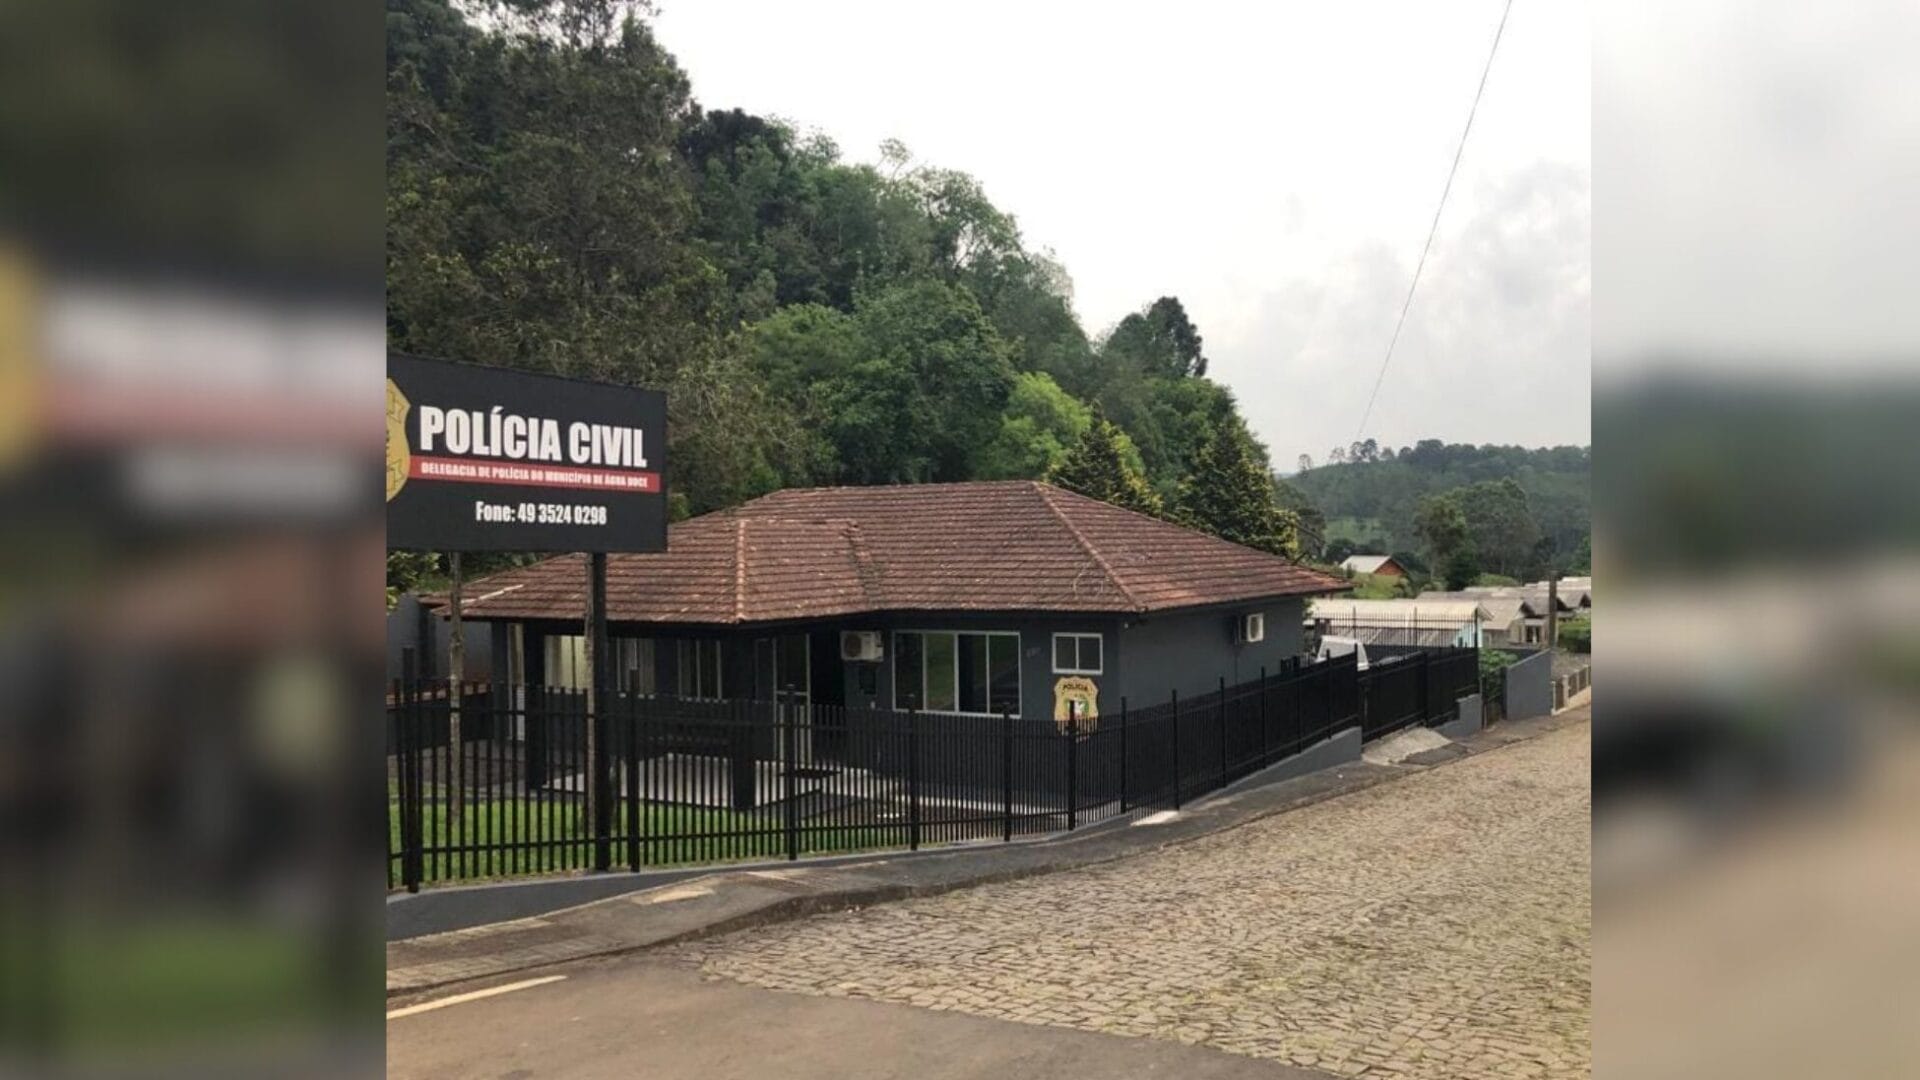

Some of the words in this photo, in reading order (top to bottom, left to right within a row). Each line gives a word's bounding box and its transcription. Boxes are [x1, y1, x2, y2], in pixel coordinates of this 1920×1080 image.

[420, 406, 562, 461] POLÍCIA
[569, 422, 647, 468] CIVIL
[421, 462, 477, 477] DELEGACIA
[478, 466, 491, 478] DE
[492, 467, 529, 480] POLÍCIA
[531, 469, 543, 481] DO
[545, 471, 591, 484] MUNICÍPIO
[476, 501, 516, 522] Fone:
[518, 503, 536, 523] 49
[538, 504, 572, 524] 3524
[574, 505, 607, 525] 0298
